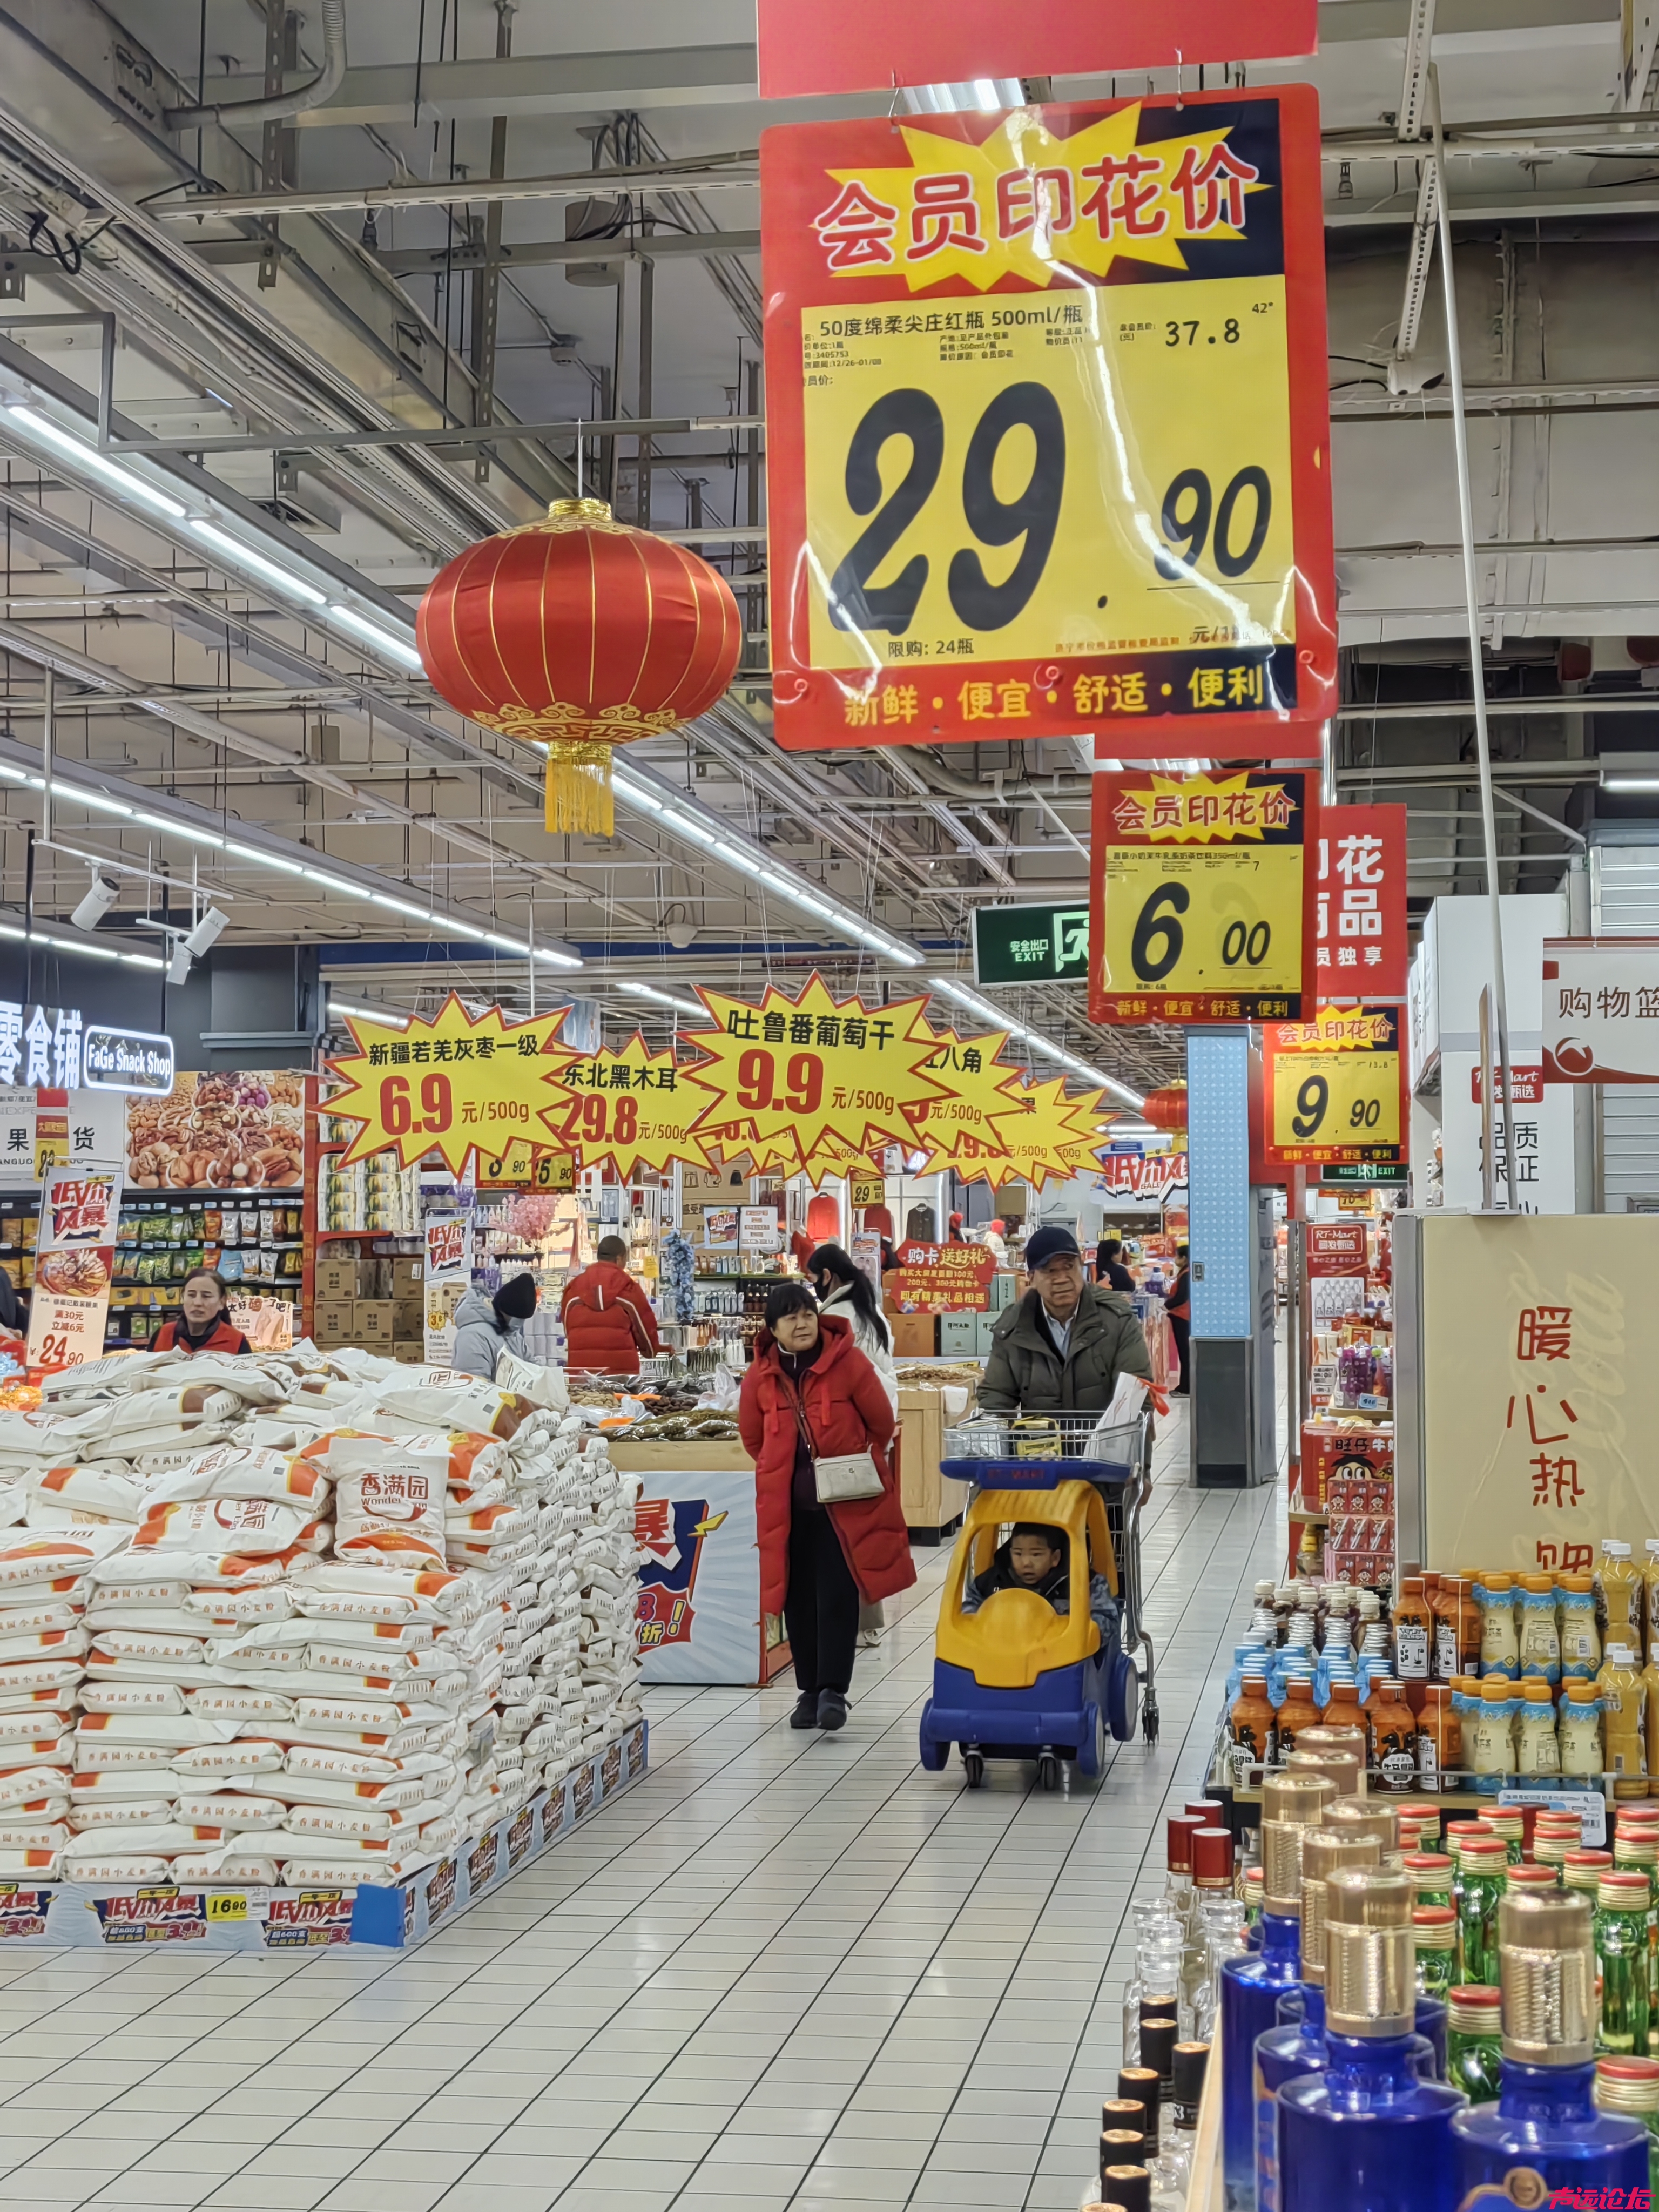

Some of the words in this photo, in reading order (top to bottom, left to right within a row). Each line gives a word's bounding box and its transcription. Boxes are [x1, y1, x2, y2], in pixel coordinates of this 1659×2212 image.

[814, 142, 1262, 271] 会员印花价
[820, 311, 986, 338] 50度绵柔尖庄红瓶
[991, 304, 1083, 327] 500ml/瓶
[1165, 318, 1240, 347] 37.8
[801, 375, 833, 386] 员价:
[935, 637, 975, 656] 24瓶
[1111, 790, 1296, 832] 会员印花价
[1253, 861, 1260, 871] 7
[1318, 834, 1384, 885] 花
[1010, 939, 1049, 952] 安全出口
[1015, 952, 1046, 962] EXIT
[1559, 986, 1659, 1019] 购物篮
[0, 1001, 83, 1089] 零食铺
[728, 1010, 895, 1051] 吐鲁番葡萄干
[1277, 1017, 1394, 1044] 会员印花价
[369, 1033, 540, 1066] 新疆若羌灰枣一级
[116, 1050, 145, 1074] Snack
[147, 1050, 171, 1080] Shop
[563, 1062, 678, 1092] 东北黑木耳
[736, 1048, 824, 1114] 9.9
[832, 1087, 894, 1116] 元/500g
[379, 1073, 453, 1136] 6.9
[461, 1100, 530, 1124] 元/500g
[930, 1101, 983, 1125] 元/500g
[558, 1094, 639, 1145] 29.8
[638, 1122, 686, 1144] 元/500g
[73, 1126, 95, 1151] 货
[1378, 1166, 1396, 1175] EXIT
[908, 1247, 990, 1269] 购卡送好礼
[360, 1473, 429, 1500] 香满园
[186, 1866, 261, 1878] 香满小麦粉
